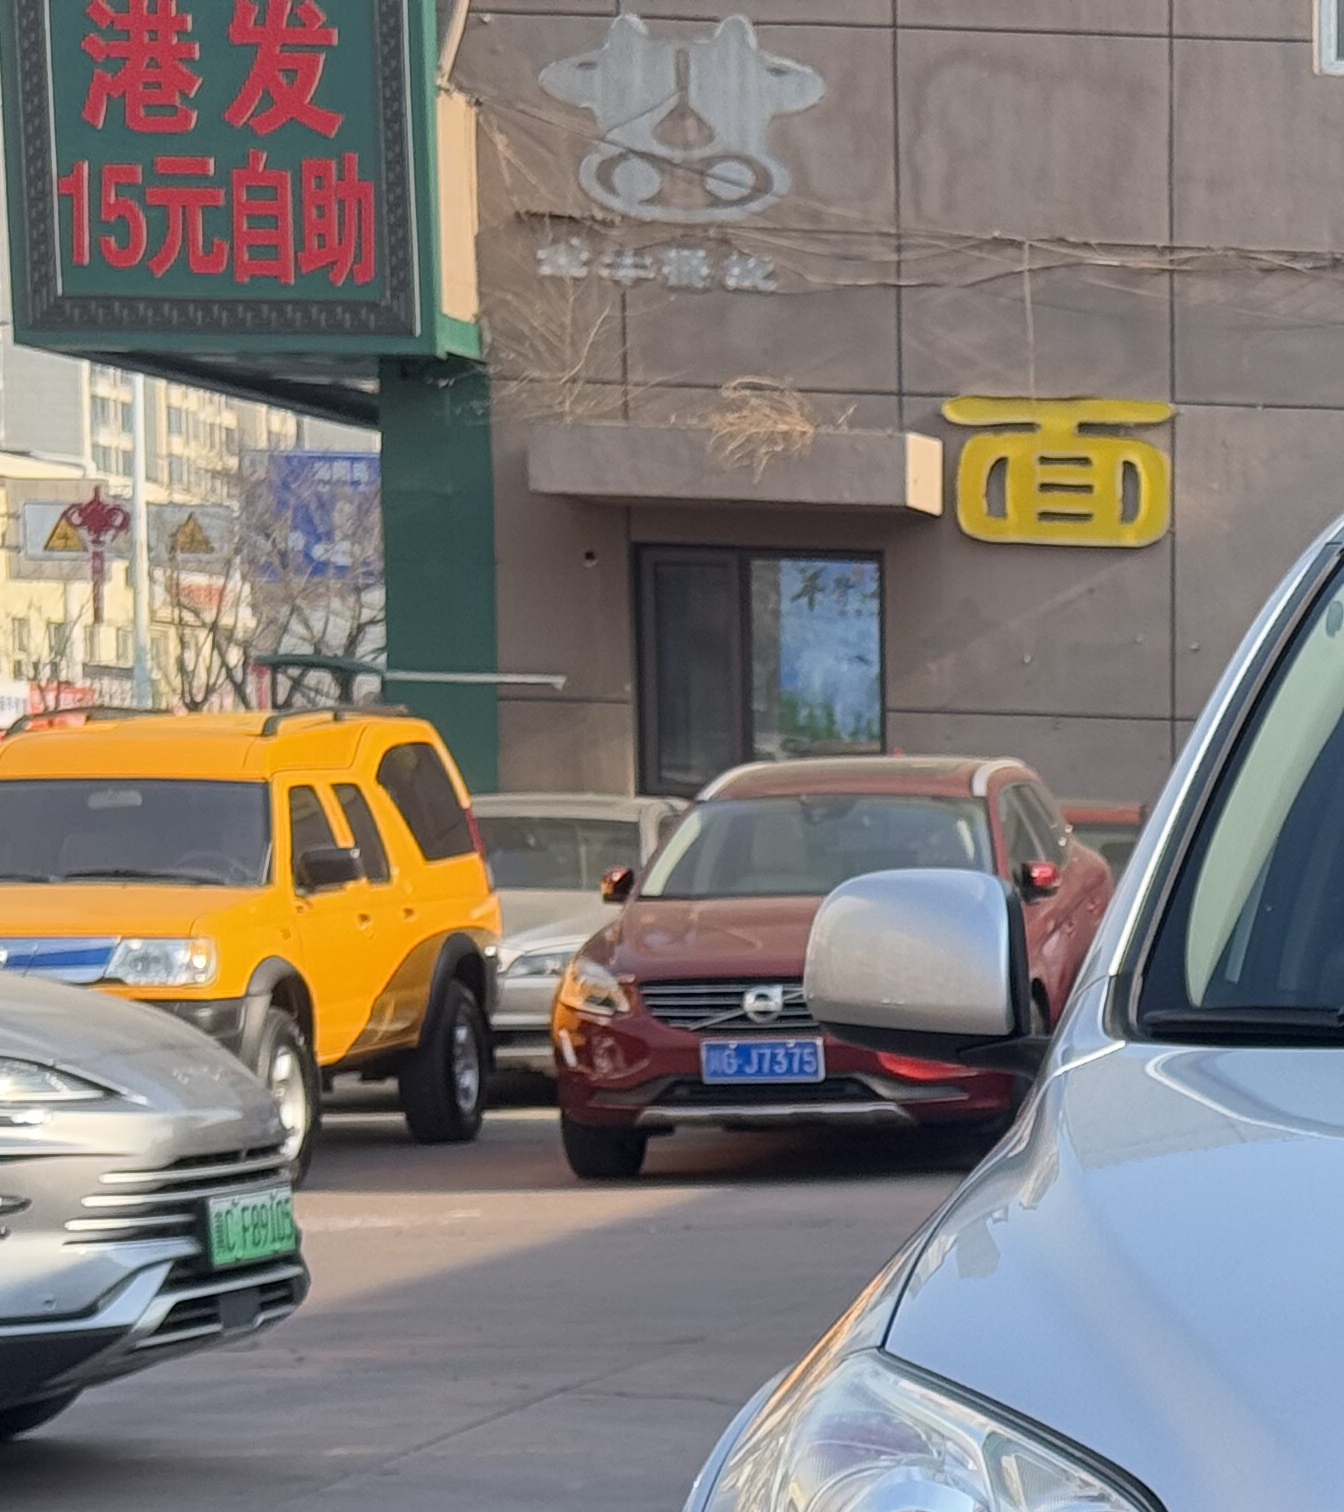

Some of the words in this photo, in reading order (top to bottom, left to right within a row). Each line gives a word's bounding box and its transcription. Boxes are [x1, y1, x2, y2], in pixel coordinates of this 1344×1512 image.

[81, 0, 343, 138] 港发
[57, 149, 375, 286] 15元自助
